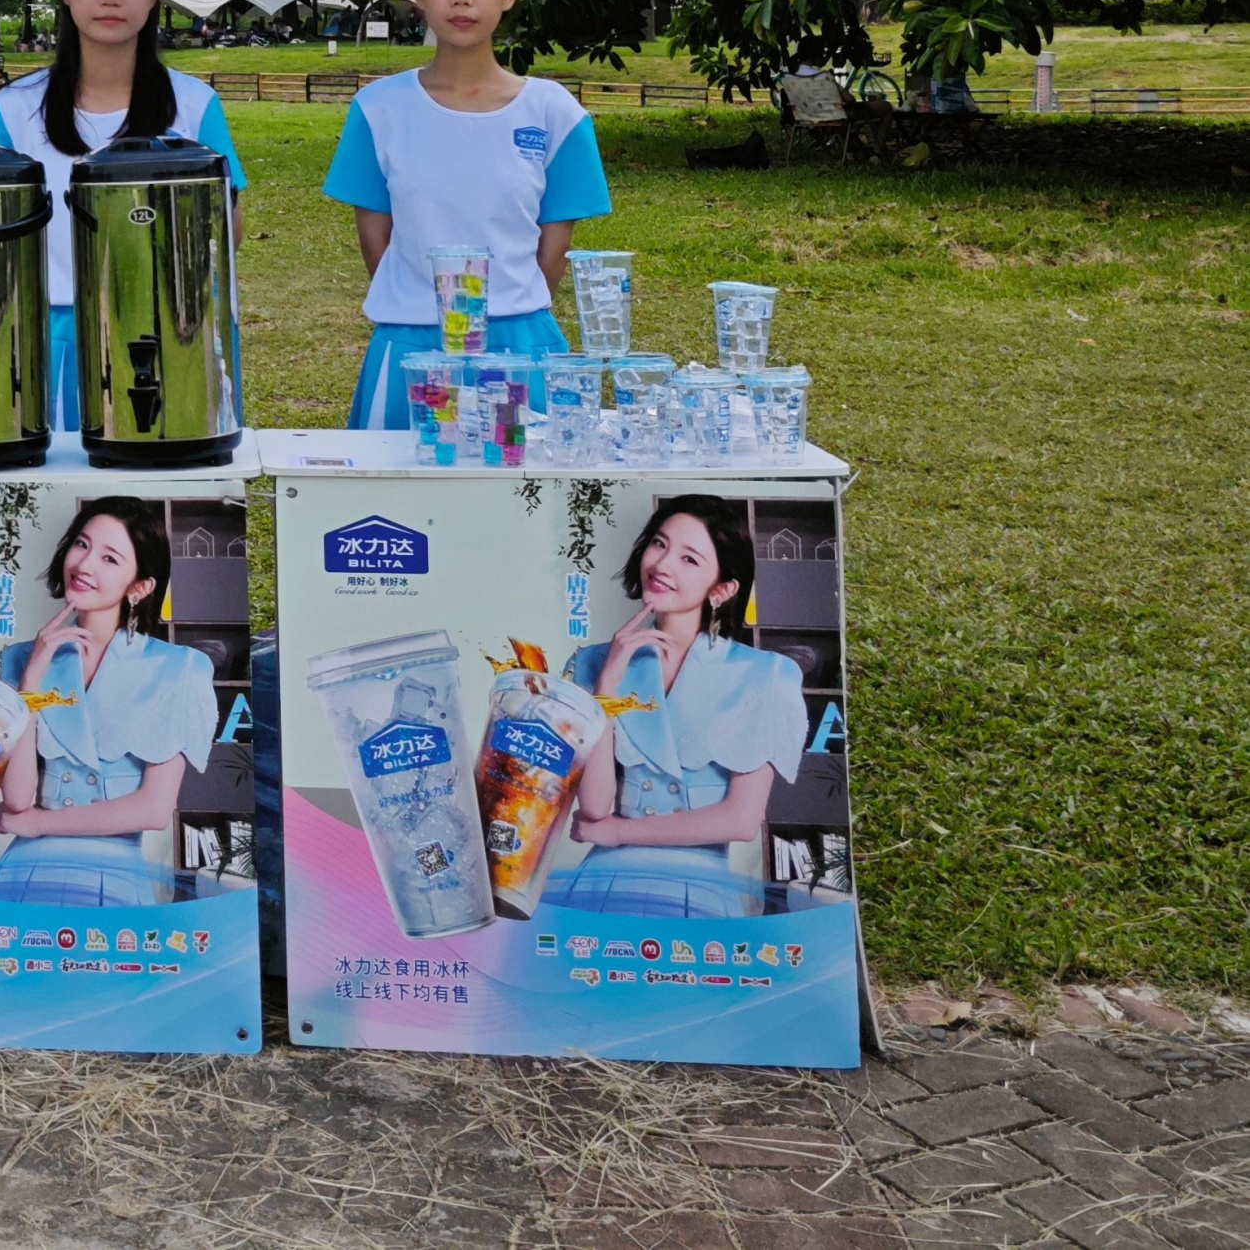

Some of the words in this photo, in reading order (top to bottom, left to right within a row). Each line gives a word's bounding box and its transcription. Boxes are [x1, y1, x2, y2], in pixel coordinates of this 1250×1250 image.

[133, 211, 152, 221] 12L
[337, 538, 414, 555] 冰力达
[348, 559, 403, 568] BILITA
[347, 577, 375, 586] 用好心
[380, 577, 408, 586] 制好冰
[567, 573, 589, 638] 唐艺昕
[370, 734, 436, 759] 冰力达
[505, 726, 563, 761] 冰力达
[383, 755, 430, 770] BILITA
[509, 744, 550, 766] BILITA
[335, 956, 470, 979] 冰力达食用冰杯
[335, 981, 469, 1004] 线上线下均有售
